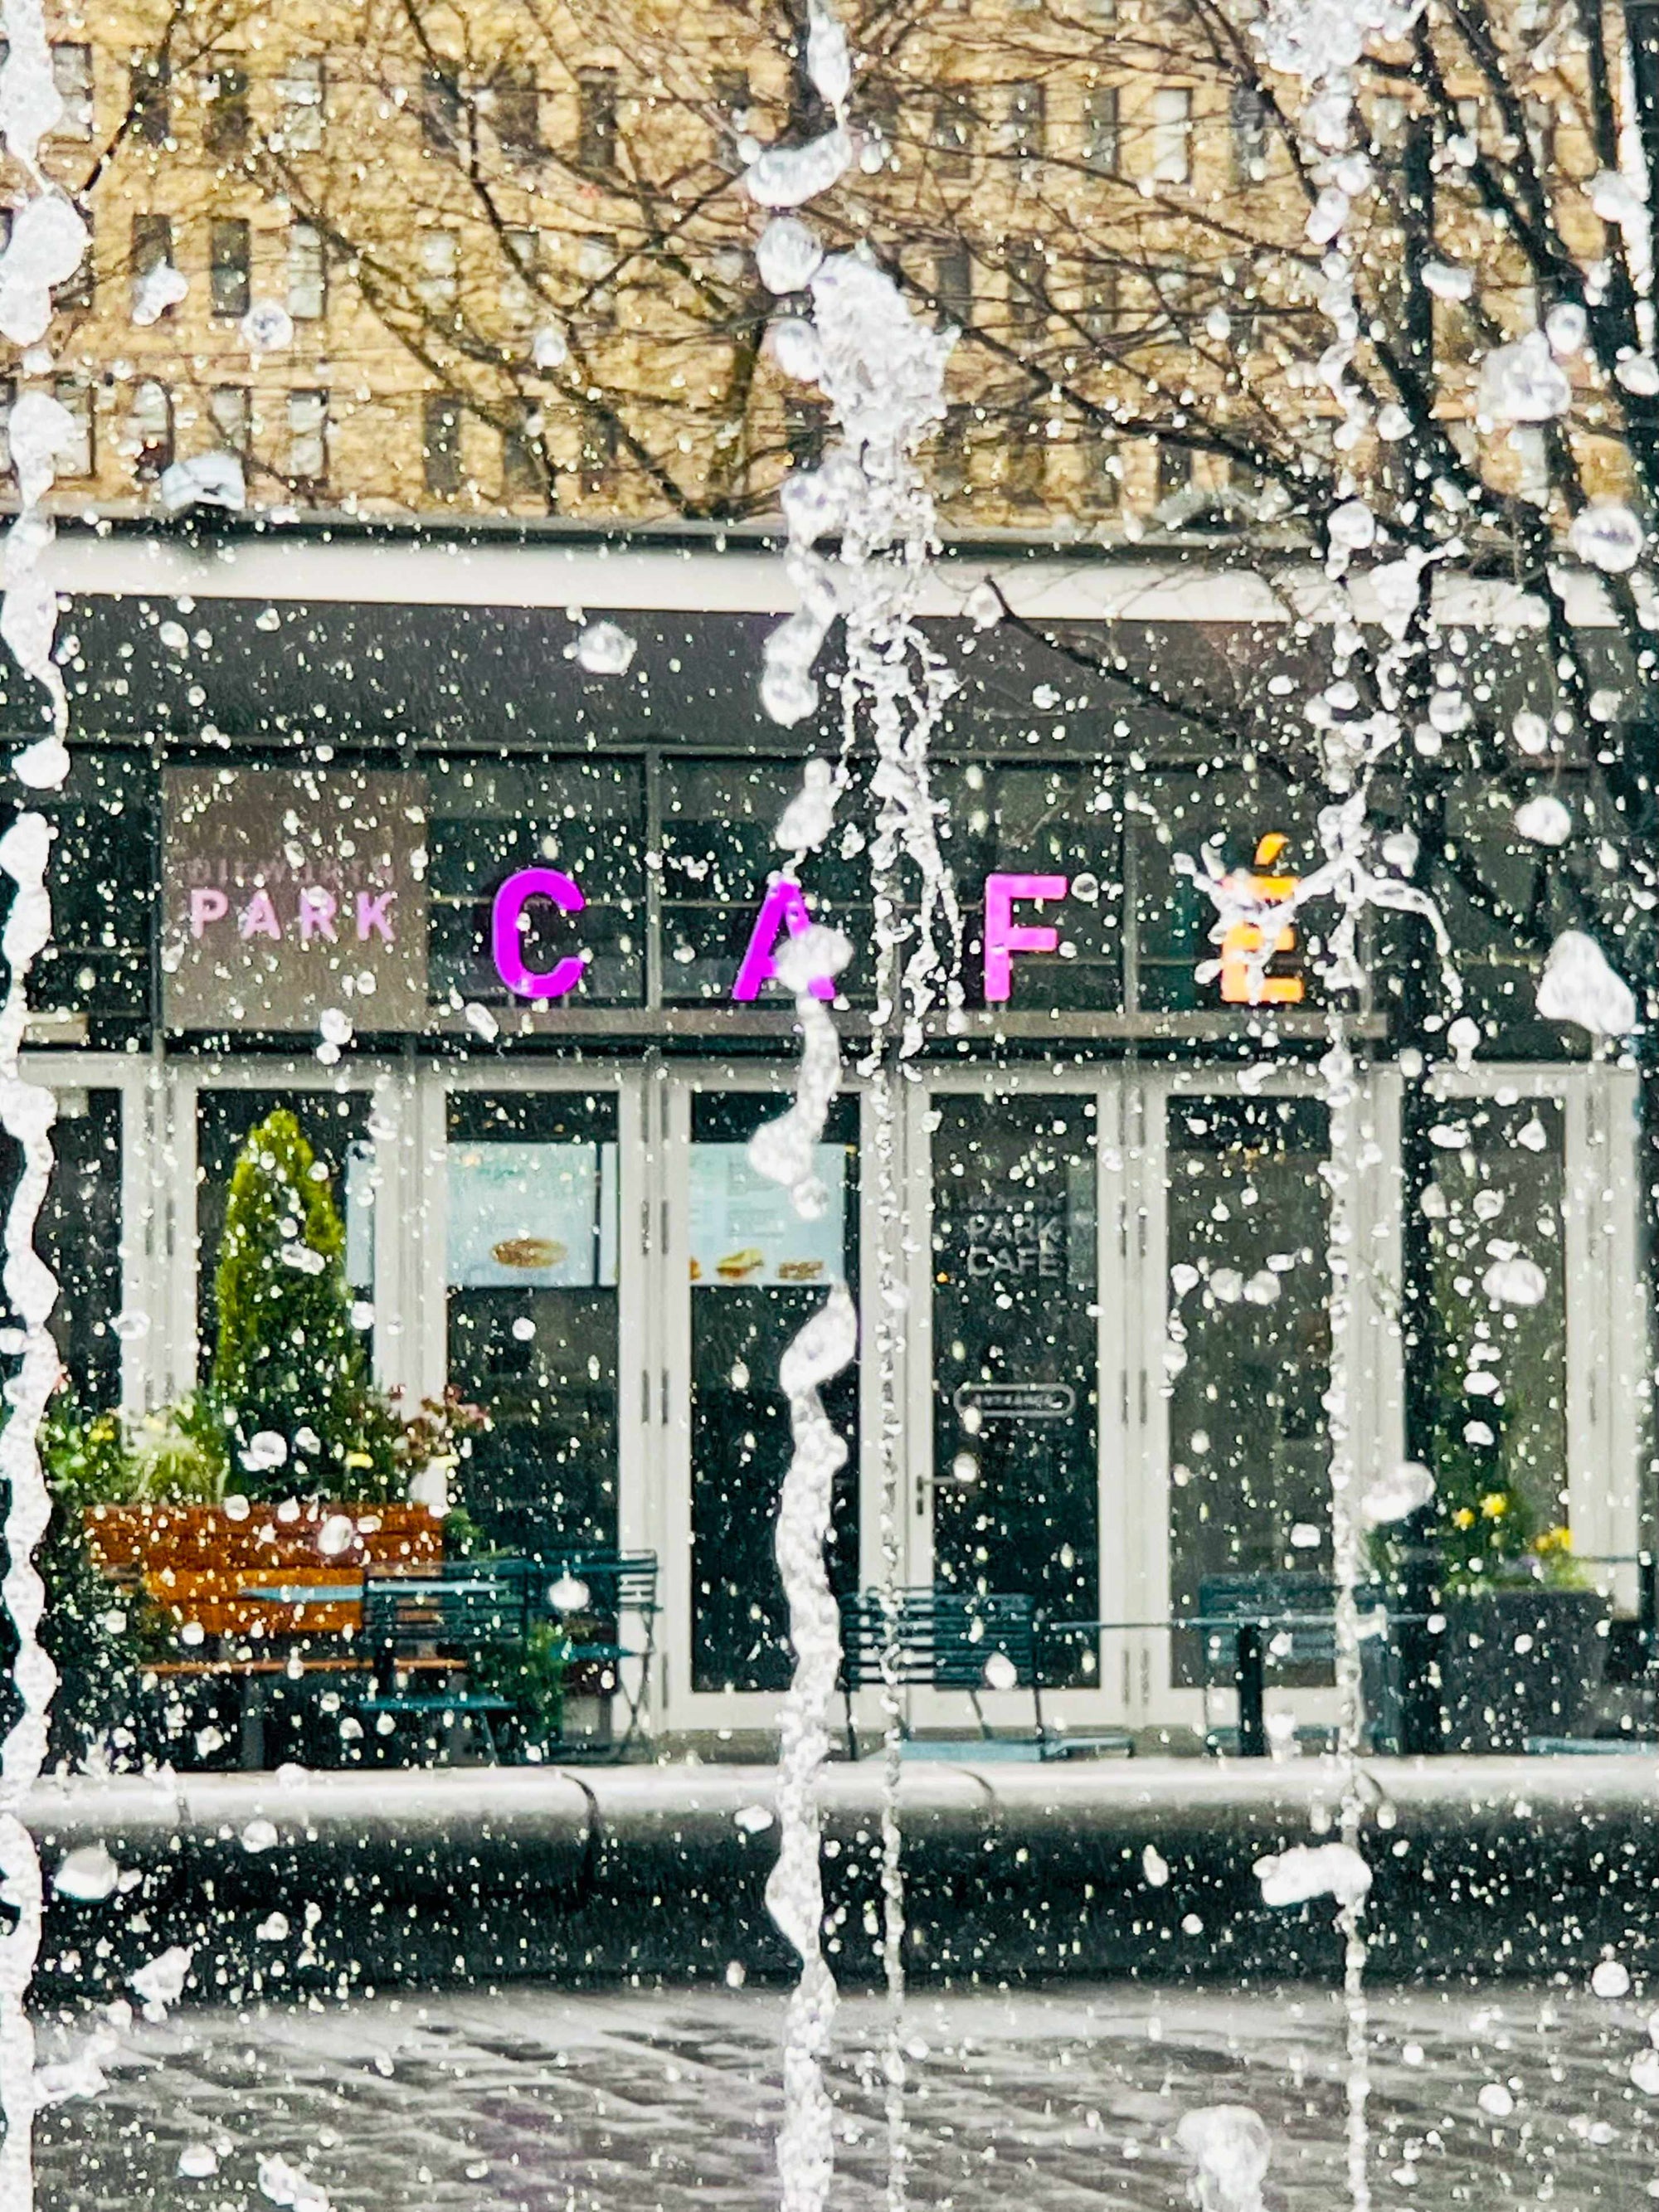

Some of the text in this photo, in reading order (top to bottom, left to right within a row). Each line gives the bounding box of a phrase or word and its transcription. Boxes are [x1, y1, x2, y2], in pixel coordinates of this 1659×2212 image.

[191, 888, 397, 941] PARK
[493, 833, 1305, 1002] CAFÉ
[968, 1215, 1058, 1244] PARK
